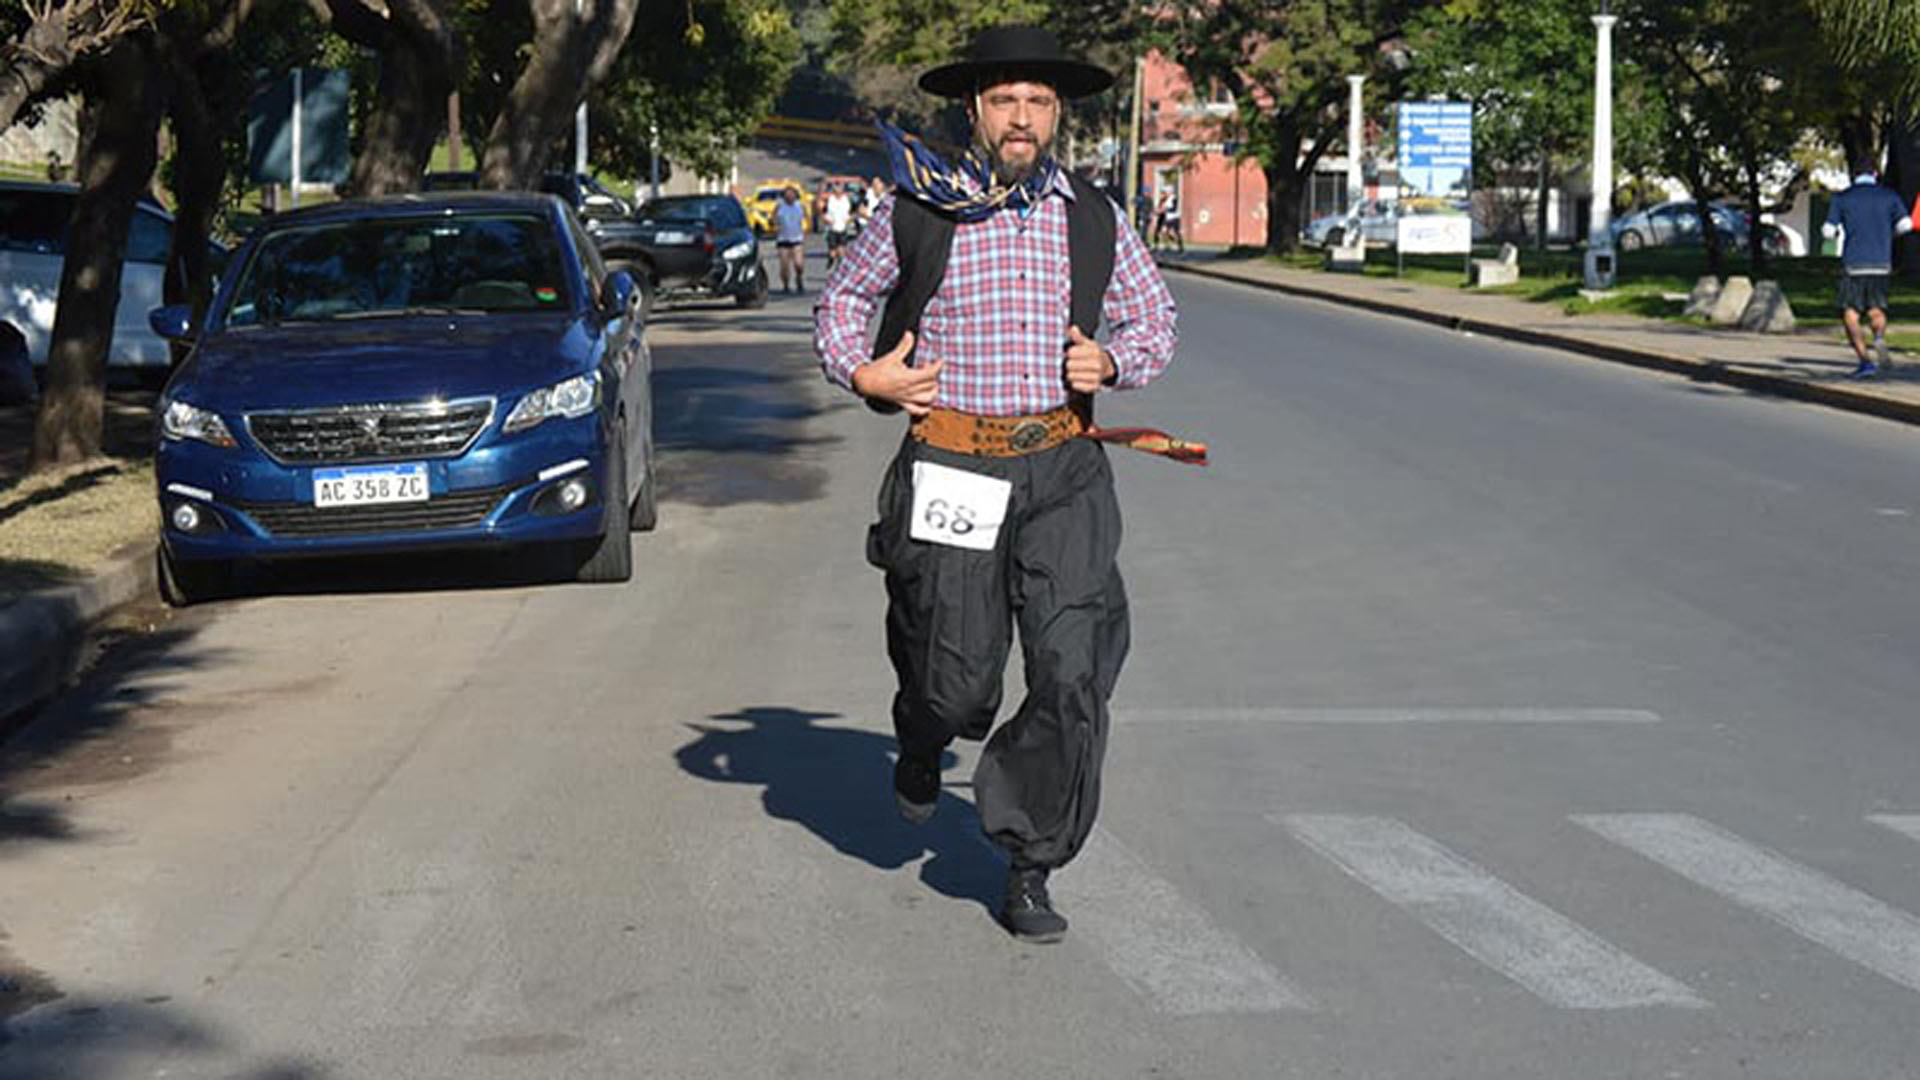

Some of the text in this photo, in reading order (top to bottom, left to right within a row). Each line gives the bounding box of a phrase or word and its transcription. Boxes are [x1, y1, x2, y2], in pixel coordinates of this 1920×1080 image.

[321, 477, 422, 501] AC 358 ZC
[925, 498, 977, 535] 68
